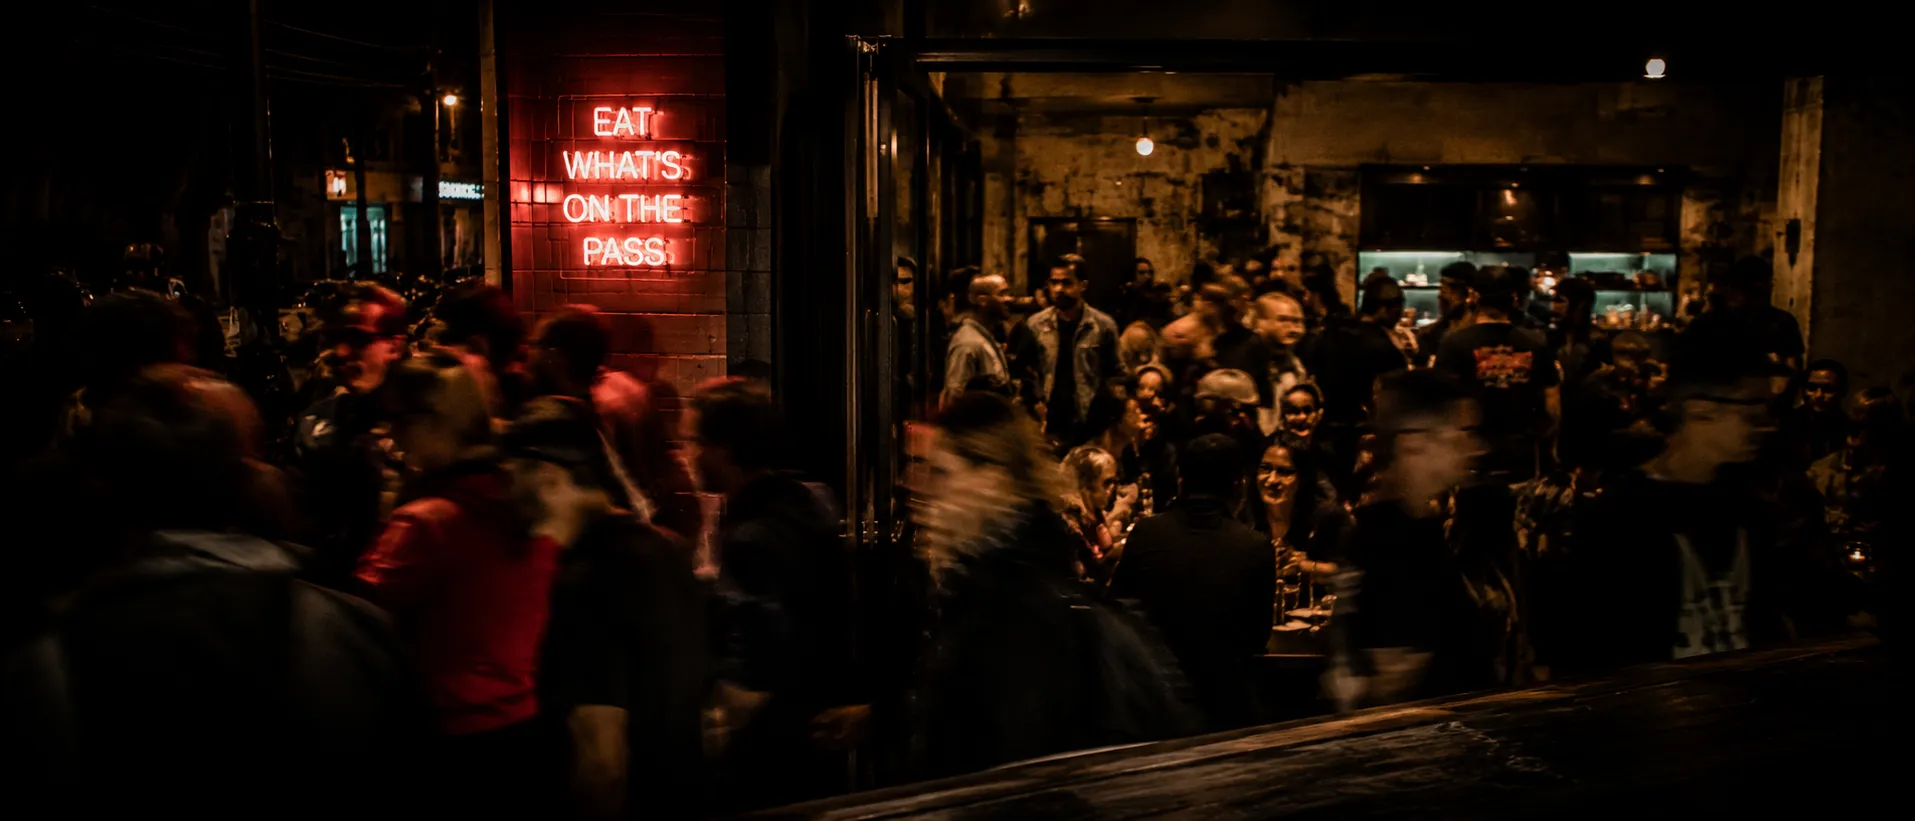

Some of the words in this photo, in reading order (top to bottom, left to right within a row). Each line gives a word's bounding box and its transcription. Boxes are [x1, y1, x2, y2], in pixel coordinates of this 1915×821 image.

[594, 107, 653, 137] EAT
[563, 150, 683, 181] WHAT'S
[563, 194, 611, 224] ON
[618, 194, 683, 224] THE
[583, 237, 666, 267] PASS
